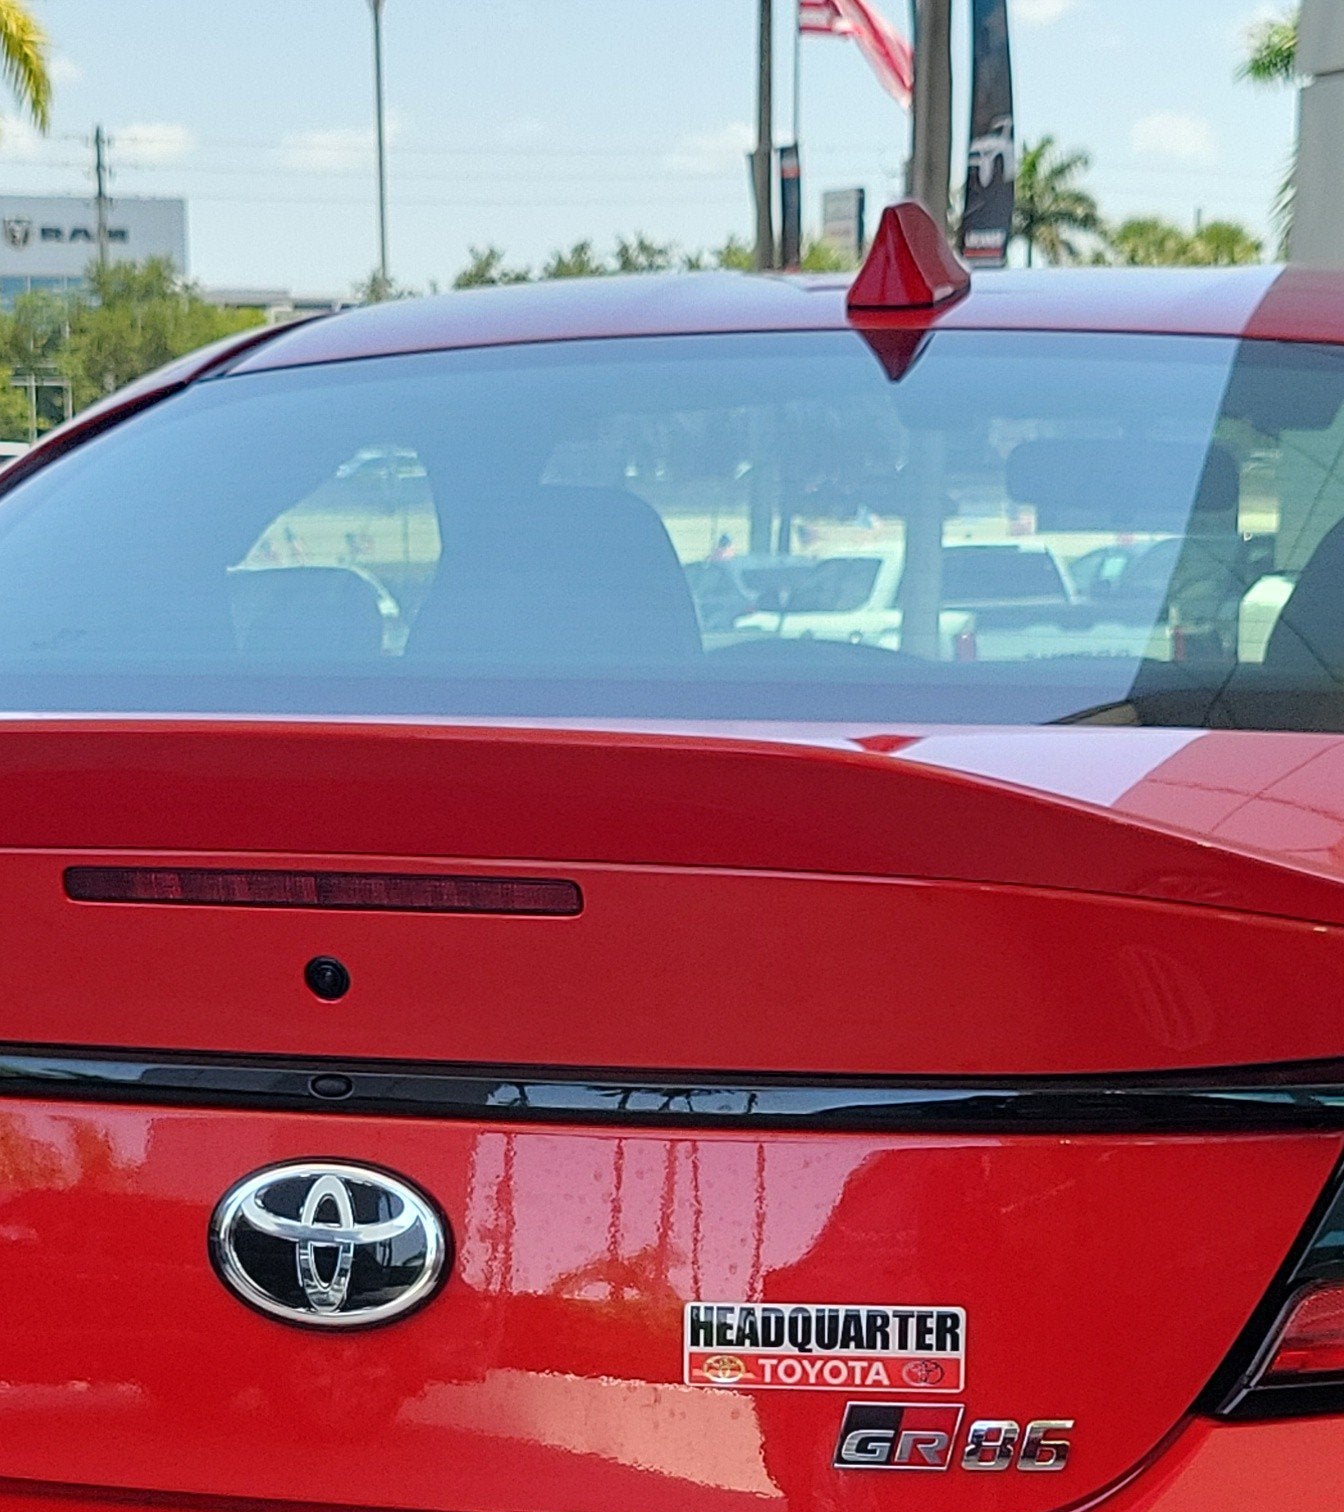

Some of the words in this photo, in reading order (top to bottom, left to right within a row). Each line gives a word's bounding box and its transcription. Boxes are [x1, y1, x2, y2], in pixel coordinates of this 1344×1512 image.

[689, 1305, 961, 1353] HEADQUARTER
[758, 1358, 891, 1386] TOYOTA
[841, 1429, 950, 1465] GR
[960, 1419, 1076, 1471] 86
